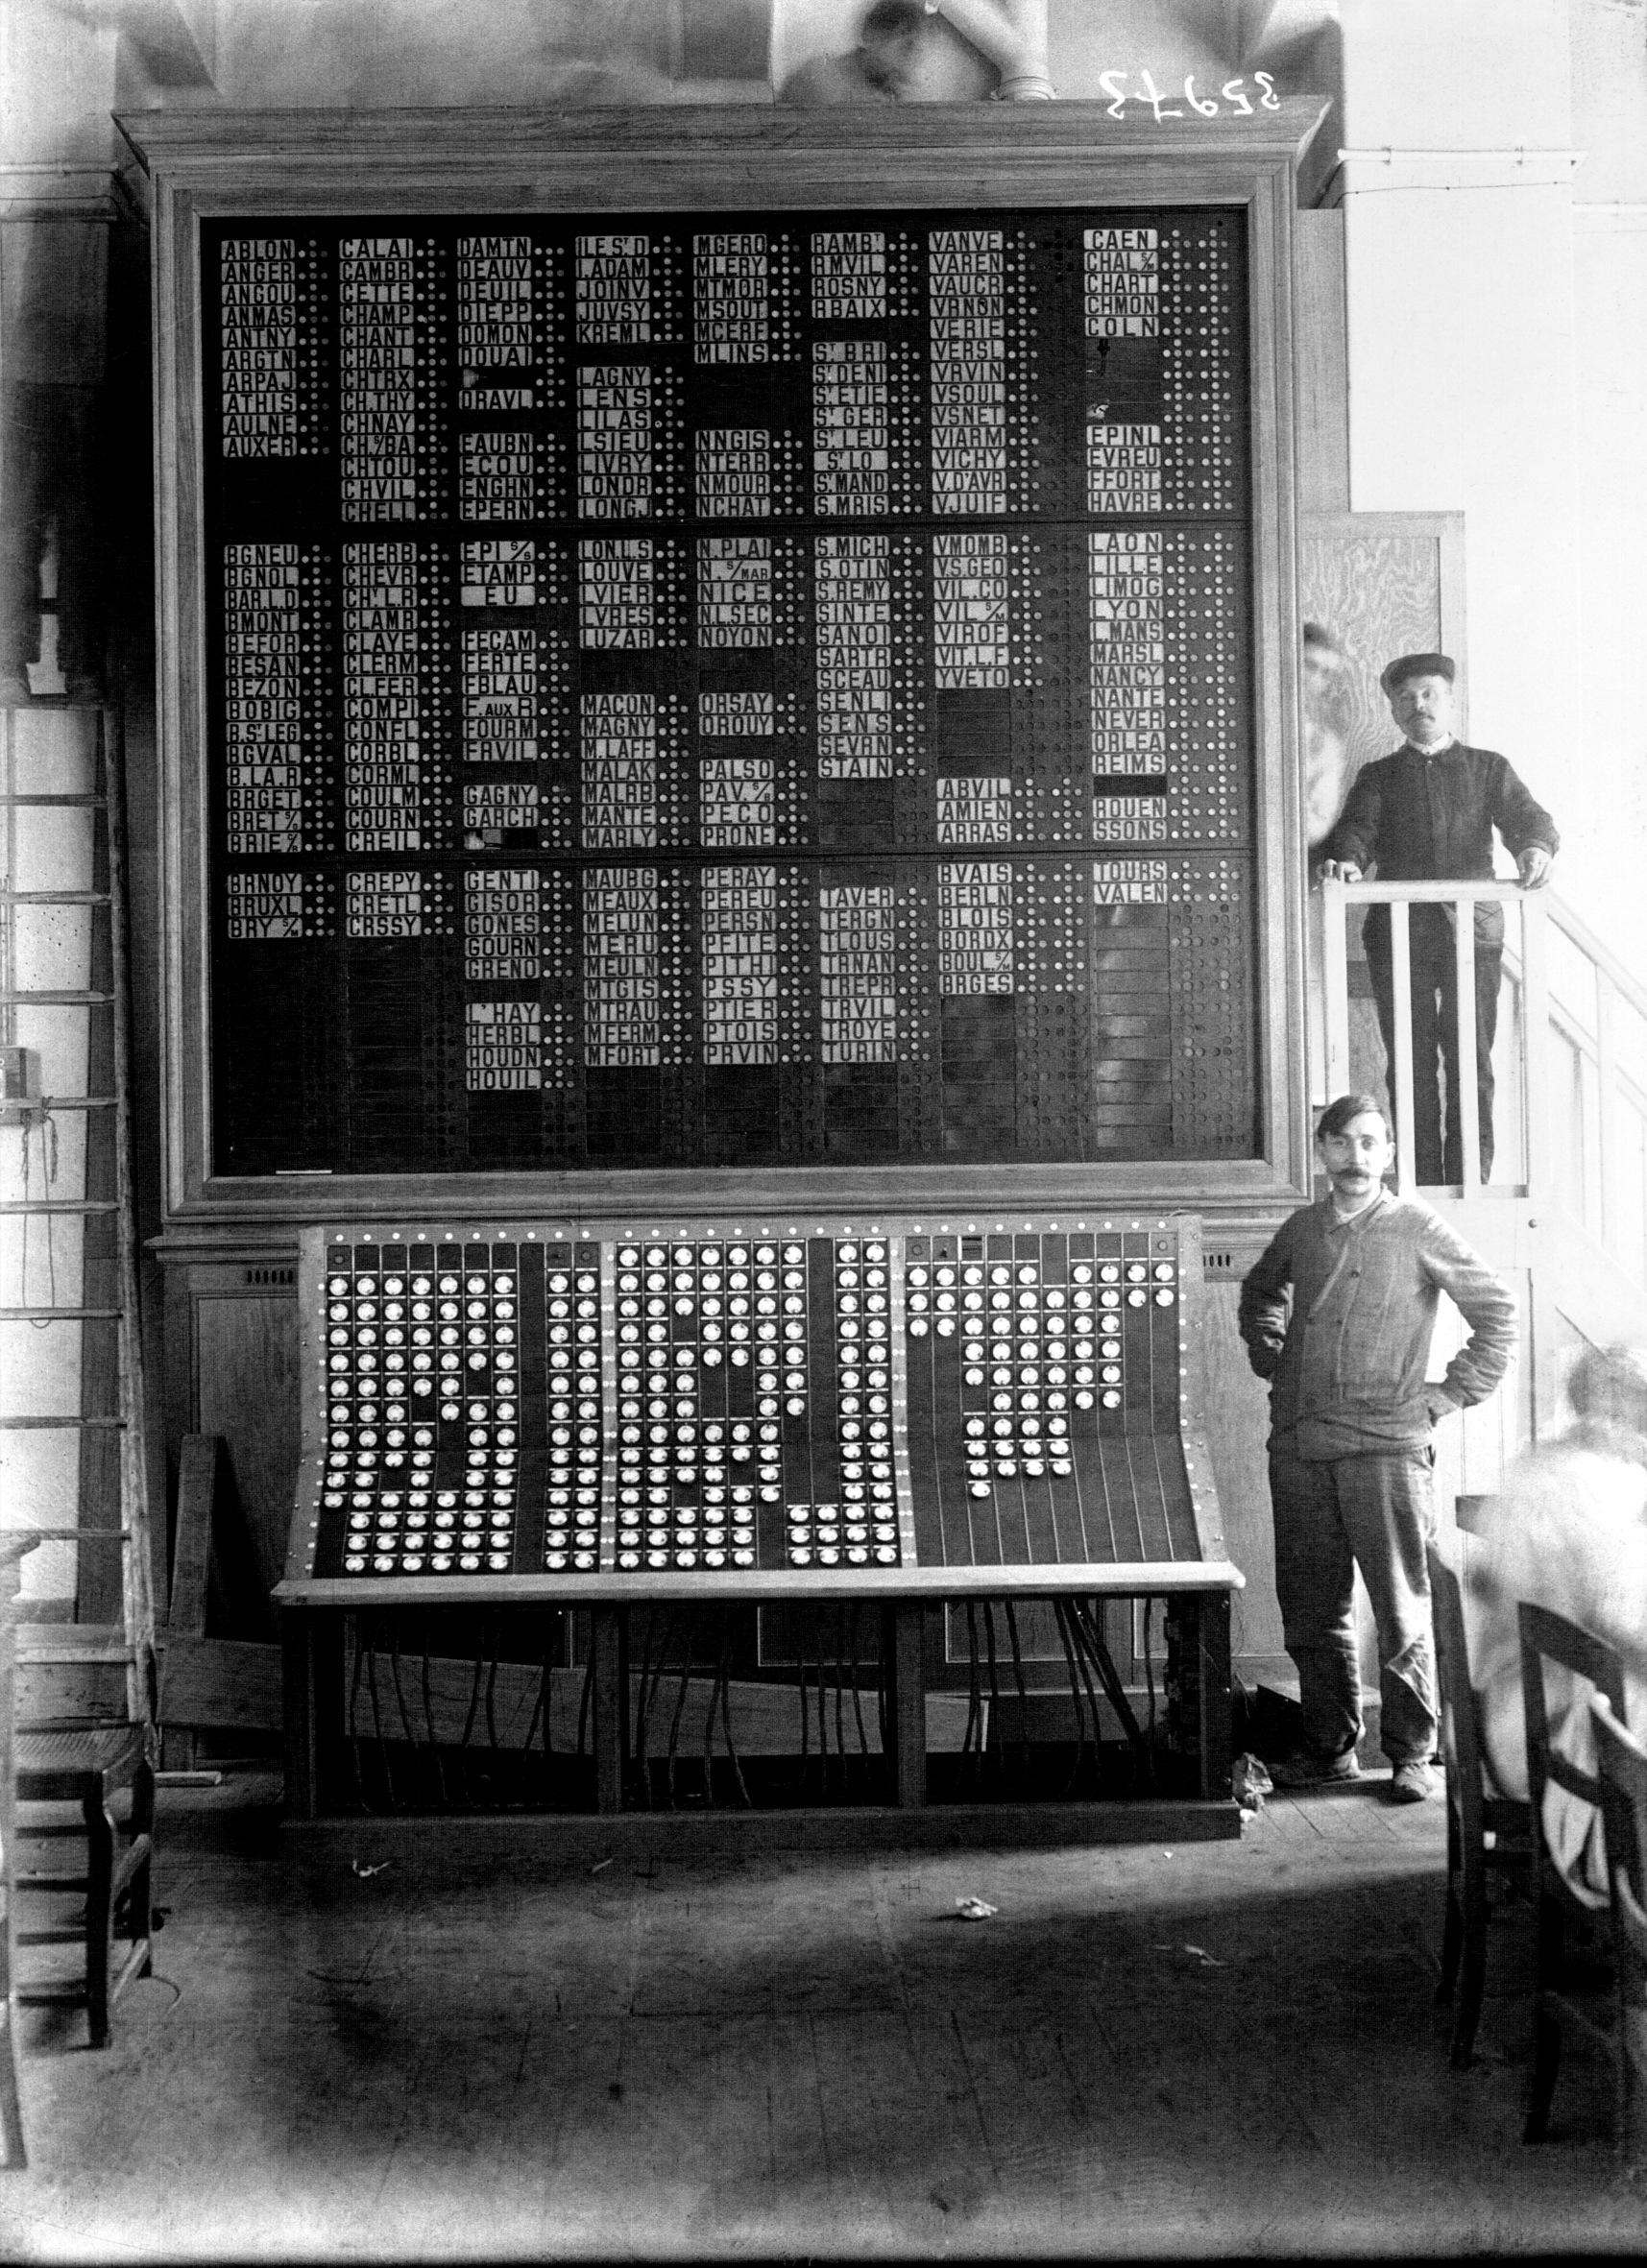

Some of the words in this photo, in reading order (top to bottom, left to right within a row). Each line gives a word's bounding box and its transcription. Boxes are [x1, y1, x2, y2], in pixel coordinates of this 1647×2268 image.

[343, 240, 411, 258] CALAI
[461, 238, 527, 256] DAMTN
[933, 232, 998, 251] VANVE
[1093, 230, 1148, 250] CAEN
[227, 241, 294, 259] ABLON
[227, 263, 291, 281] ANGER
[343, 262, 409, 280] CAMBR
[461, 260, 526, 278] DEAUV
[696, 257, 761, 276] MLERY
[934, 254, 999, 273] VAREN
[343, 284, 409, 302] CETTE
[580, 281, 643, 299] JOINV
[814, 277, 879, 296] ROSNY
[934, 277, 1000, 295] VAUCR
[1088, 275, 1152, 293] CHART
[227, 285, 292, 303] ANGOU
[343, 305, 409, 324] CHAMP
[461, 304, 527, 322] DIEPP
[579, 302, 644, 321] JUVSY
[697, 302, 763, 319] MSOUT
[815, 300, 881, 318] RBAIX
[1088, 297, 1154, 315] CHMON
[228, 307, 292, 326] ANMAS
[344, 327, 408, 346] CHANT
[934, 320, 1000, 338] VERIE
[1088, 318, 1154, 336] COLN
[344, 350, 410, 368] CHARL
[462, 348, 531, 366] DOUAI
[698, 345, 764, 363] MLINS
[580, 368, 644, 386] LAGNY
[229, 394, 292, 413] ATHIS
[580, 390, 646, 407] LENS
[936, 385, 1003, 403] VSOUL
[344, 414, 409, 432] CHNAY
[580, 411, 647, 429] LILAS
[935, 407, 1001, 425] VSNET
[462, 434, 532, 452] EAUBN
[936, 428, 1002, 446] VIARM
[229, 438, 296, 456] AUXER
[344, 458, 411, 476] CHTOU
[463, 457, 529, 474] ECOU
[581, 455, 644, 473] LIVRY
[699, 453, 765, 471] NTERR
[937, 450, 999, 469] VICHY
[1090, 448, 1156, 467] EVREU
[581, 477, 647, 495] LONDR
[699, 475, 765, 494] NMOUR
[1091, 470, 1156, 489] FFORT
[699, 497, 765, 517] NCHAT
[1091, 493, 1156, 512] HAVRE
[938, 536, 1003, 555] VMOMB
[1092, 534, 1158, 553] LAON
[228, 545, 294, 565] BGNEU
[346, 544, 412, 563] CHERB
[464, 565, 531, 583] ETAMP
[582, 563, 647, 582] LOUVE
[1091, 556, 1157, 574] LILLE
[346, 567, 415, 585] CHEVR
[486, 587, 517, 606] EU
[701, 584, 768, 602] NICE
[1093, 578, 1159, 597] LIMOG
[819, 604, 884, 622] SINTE
[1093, 600, 1159, 619] LYON
[229, 613, 295, 631] BMONT
[347, 611, 413, 630] CLAMR
[347, 634, 413, 652] CLAYE
[465, 631, 534, 650] FECAM
[583, 630, 650, 648] LUZAR
[701, 628, 770, 647] NOYON
[819, 626, 886, 645] SANOI
[939, 625, 1004, 643] VIROF
[229, 635, 295, 653] BEFOR
[465, 656, 531, 672] FERTE
[820, 649, 886, 667] SARTR
[1094, 645, 1160, 664] MARSL
[229, 657, 298, 675] BESAN
[465, 676, 532, 694] FBLAU
[821, 670, 887, 688] SCEAU
[940, 669, 1005, 688] YVETO
[1094, 666, 1160, 686] NANCY
[229, 679, 296, 697] BEZON
[584, 695, 652, 714] MACON
[702, 694, 766, 713] ORSAY
[821, 692, 888, 711] SENLI
[1095, 688, 1159, 708] NANTE
[230, 701, 296, 720] BOBIG
[348, 699, 414, 718] COMPI
[585, 718, 649, 736] MAGNY
[821, 714, 887, 733] SENS
[1095, 712, 1160, 730] NEVER
[348, 722, 417, 740] CONFL
[1095, 733, 1161, 752] ORLEA
[230, 745, 297, 764] BGVAL
[703, 760, 770, 780] PALSO
[821, 759, 888, 778] STAIN
[1096, 755, 1161, 774] REIMS
[467, 786, 535, 805] GAGNY
[944, 780, 1004, 798] ABVIL
[467, 808, 535, 827] GARCH
[586, 807, 651, 825] MANTE
[703, 805, 771, 823] PECO
[943, 802, 1006, 820] AMIEN
[1096, 799, 1161, 818] ROUEN
[349, 810, 416, 829] COURN
[586, 829, 651, 847] MARLY
[704, 827, 770, 846] PRONE
[942, 824, 1006, 842] ARRAS
[1097, 821, 1162, 840] SSONS
[350, 832, 415, 851] CREIL
[468, 871, 534, 890] GENTI
[587, 870, 653, 889] MAUBG
[705, 868, 767, 887] PERAY
[941, 864, 1007, 883] BVAIS
[1096, 862, 1162, 881] TOURS
[231, 875, 294, 894] BRNOY
[350, 873, 414, 892] CREPY
[468, 894, 535, 912] GISOR
[587, 892, 652, 911] MEAUX
[705, 890, 772, 909] PEREU
[823, 889, 890, 907] TAVER
[1099, 884, 1162, 904] VALEN
[231, 897, 298, 916] BRUXL
[350, 917, 414, 936] CRSSY
[469, 916, 535, 934] GONES
[587, 914, 654, 932] MELUN
[942, 909, 1007, 928] BLOIS
[469, 937, 535, 956] GOURN
[587, 936, 655, 954] MERU
[823, 932, 890, 952] TLOUS
[942, 930, 1007, 950] BORDX
[469, 960, 536, 978] GRENO
[706, 956, 773, 976] PITHI
[588, 980, 654, 999] MTGIS
[706, 978, 765, 998] PSSY
[824, 977, 891, 996] TREPR
[943, 975, 1008, 994] BRGES
[706, 1001, 773, 1020] PTIER
[707, 1023, 774, 1042] PTOIS
[825, 1022, 890, 1040] TROYE
[470, 1049, 538, 1068] HOUDN
[589, 1047, 655, 1066] MFORT
[707, 1045, 774, 1064] PRVIN
[825, 1043, 891, 1062] TURIN
[471, 1071, 536, 1090] HOUIL
